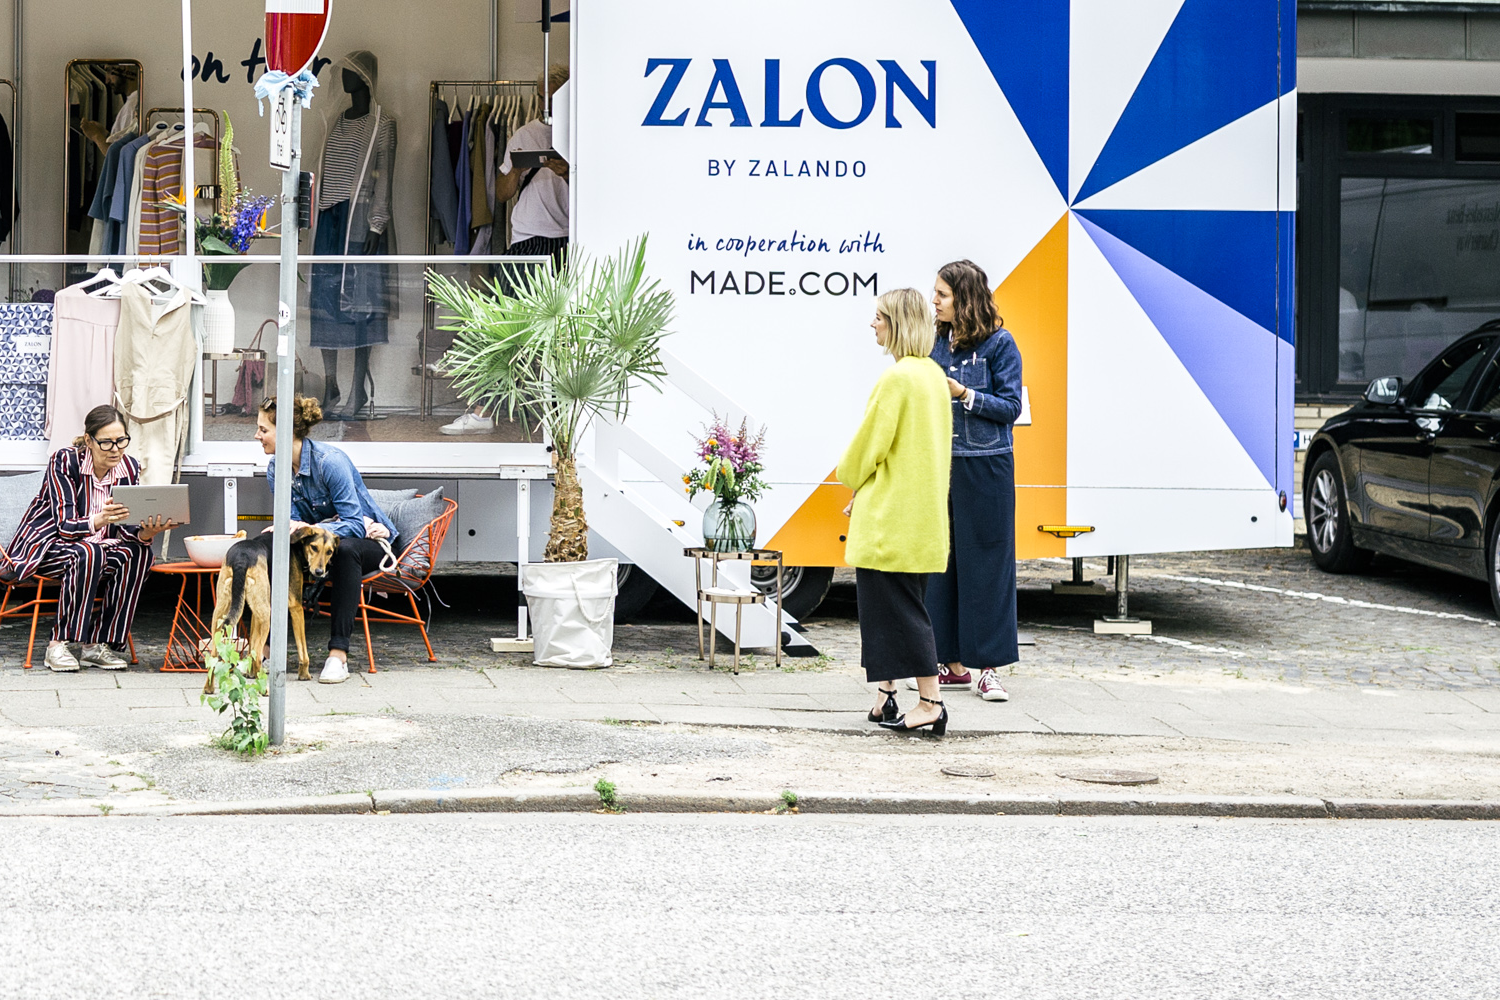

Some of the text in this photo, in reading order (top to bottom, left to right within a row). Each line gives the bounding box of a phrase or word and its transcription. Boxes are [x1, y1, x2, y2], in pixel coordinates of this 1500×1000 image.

[241, 37, 332, 84] tr
[641, 57, 937, 129] ZALON
[707, 159, 867, 178] BY ZALANDO
[687, 230, 885, 257] in cooperation with
